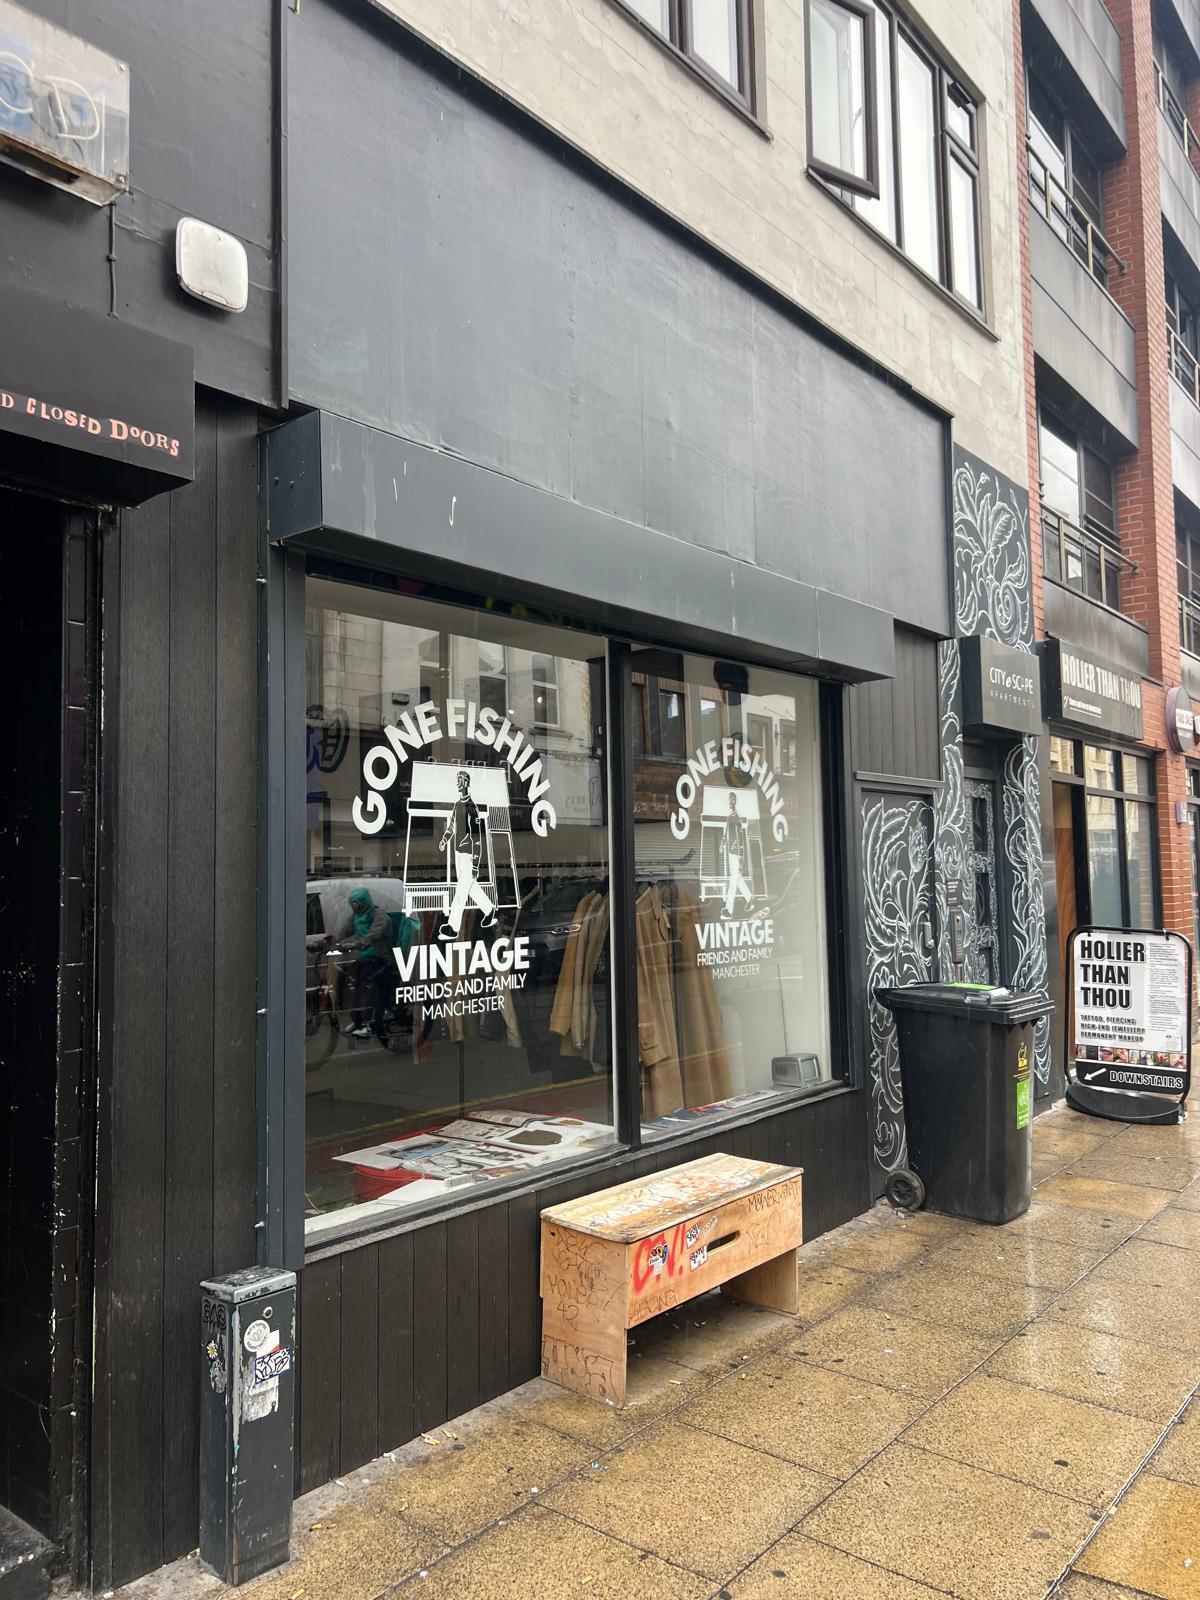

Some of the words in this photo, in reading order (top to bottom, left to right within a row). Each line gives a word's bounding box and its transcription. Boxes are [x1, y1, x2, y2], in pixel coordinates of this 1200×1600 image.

[26, 397, 102, 435] CLOSED
[1062, 653, 1096, 693] HOLIER
[1096, 666, 1120, 701] THAN
[1120, 676, 1141, 709] THOU
[352, 700, 444, 834] GONE
[446, 699, 557, 838] FISHING
[670, 740, 721, 840] GONE
[722, 737, 789, 843] FISHING
[695, 919, 774, 950] VINTAGE
[392, 936, 530, 982] VINTAGE
[697, 949, 730, 967] FRIENDS
[731, 949, 747, 963] AND
[748, 946, 773, 960] FAMILY
[1080, 940, 1145, 962] HOLIER
[712, 963, 761, 980] MANCHESTER
[1080, 964, 1130, 985] THAN
[395, 980, 453, 1004] FRIENDS
[454, 978, 484, 997] AND
[485, 972, 527, 993] FAMILY
[1080, 987, 1131, 1009] THOU
[422, 996, 505, 1021] MANCHESTER
[1109, 1071, 1184, 1089] DOWNSTAIRS
